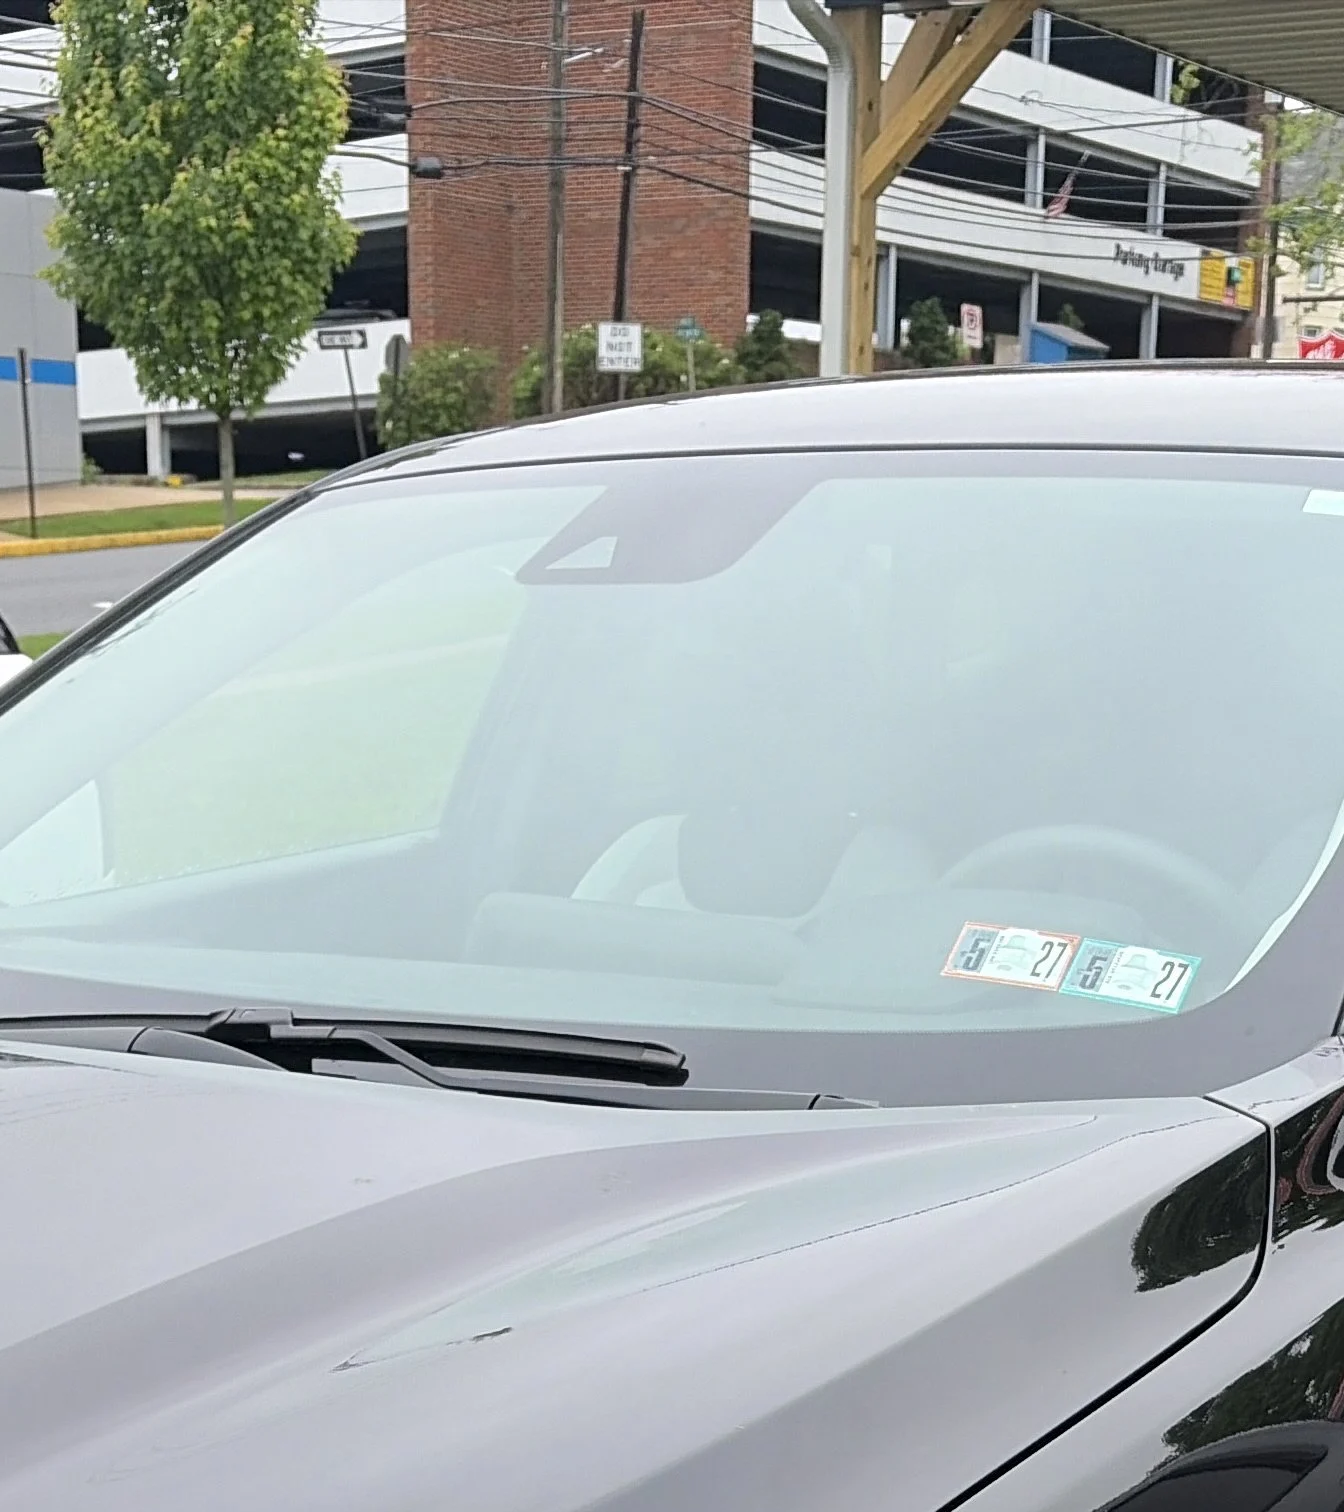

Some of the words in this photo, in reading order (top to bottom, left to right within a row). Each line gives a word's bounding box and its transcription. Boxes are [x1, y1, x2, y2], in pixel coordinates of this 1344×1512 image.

[606, 341, 633, 353] NOT
[1030, 940, 1069, 979] 27
[1150, 961, 1190, 1001] 27
